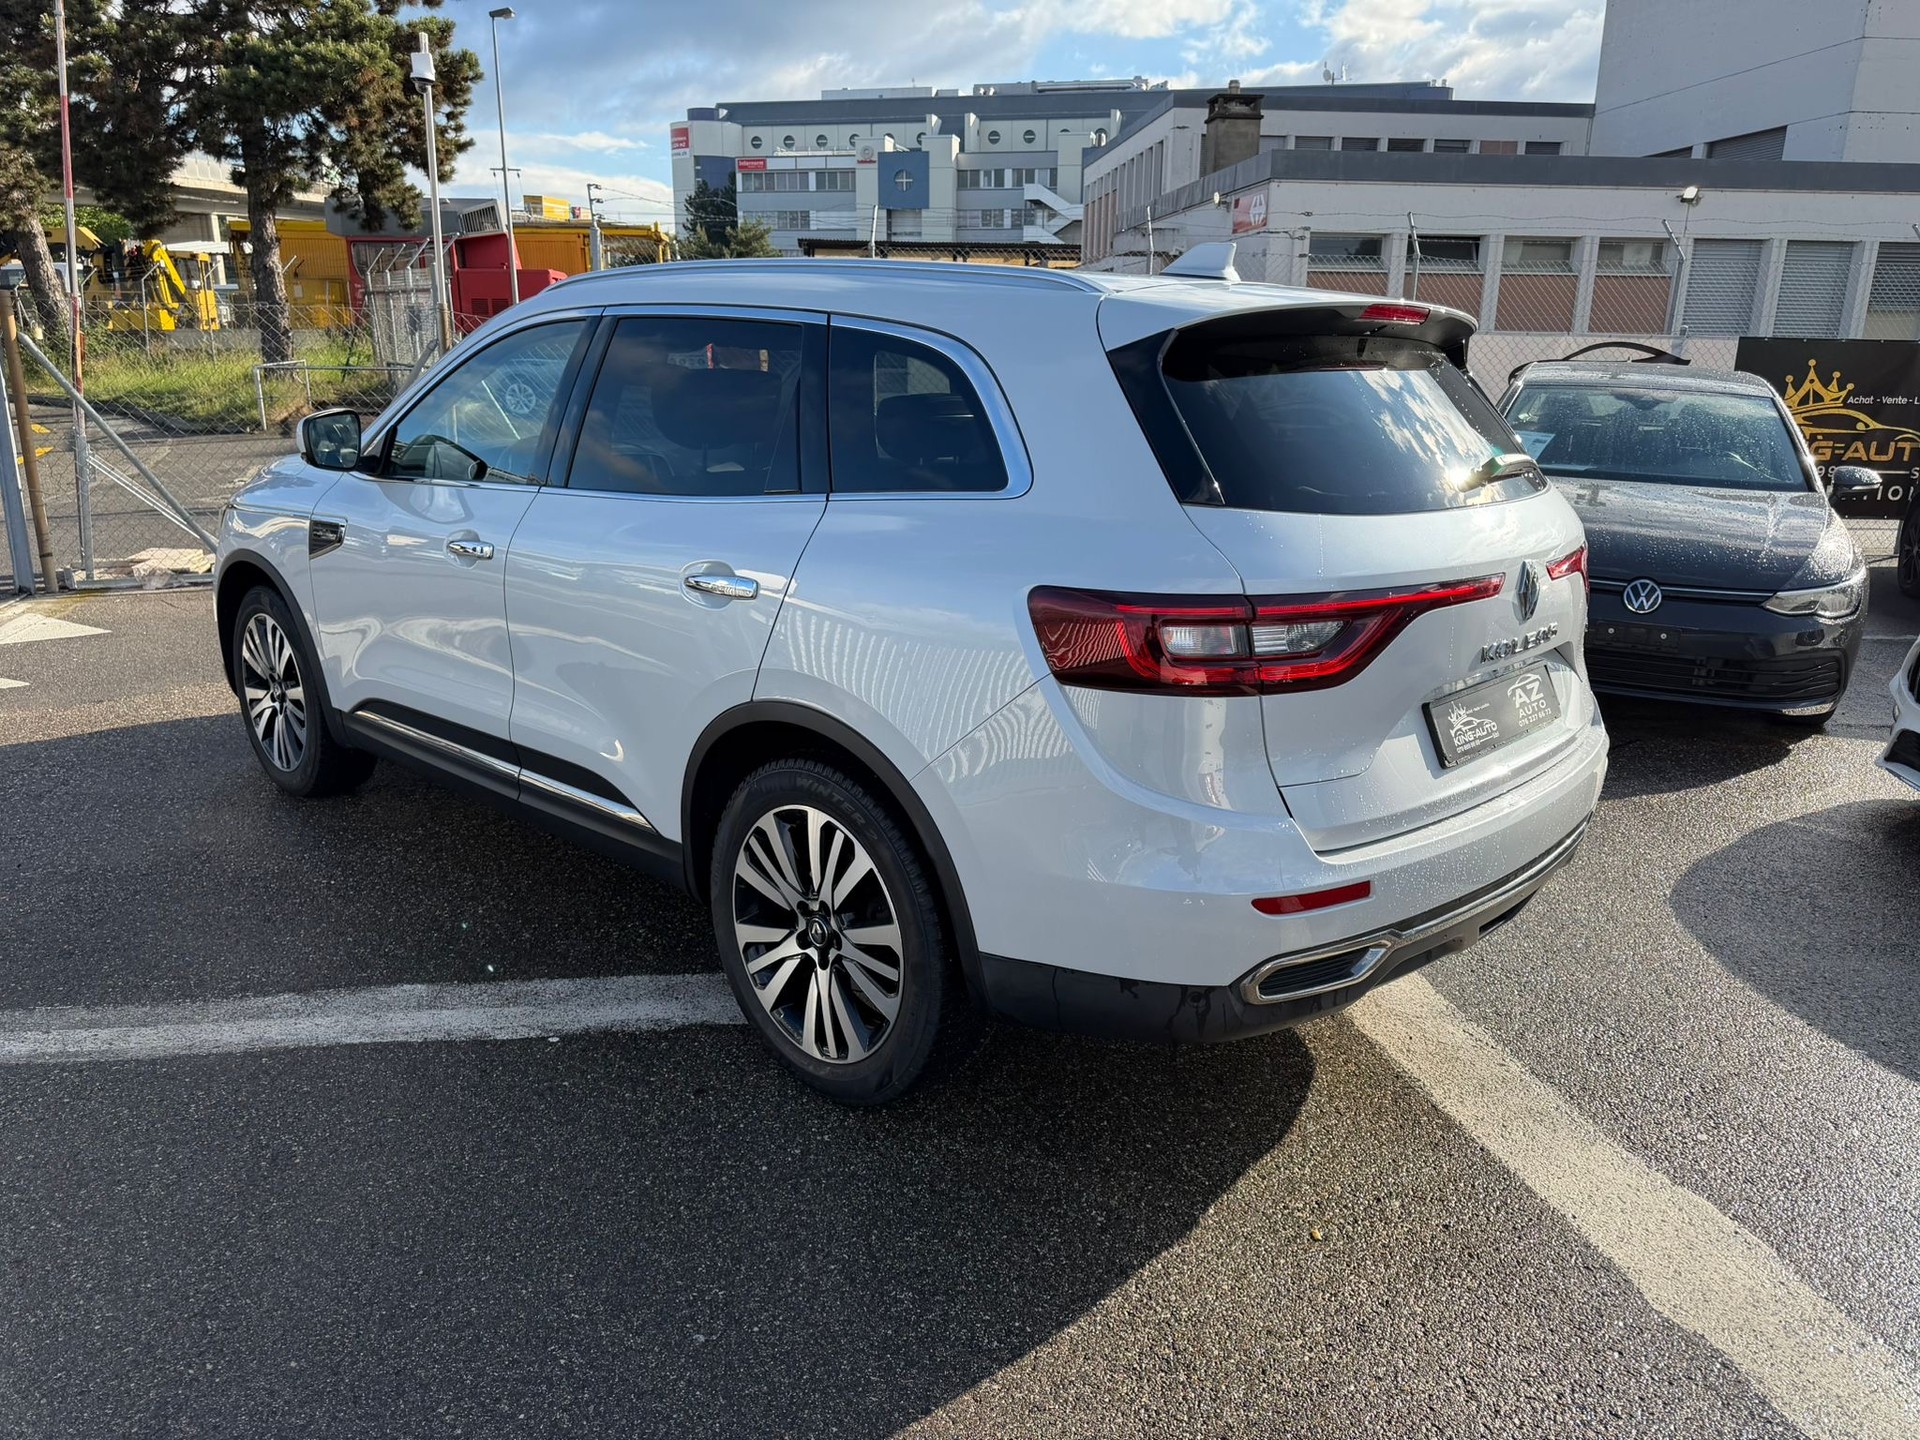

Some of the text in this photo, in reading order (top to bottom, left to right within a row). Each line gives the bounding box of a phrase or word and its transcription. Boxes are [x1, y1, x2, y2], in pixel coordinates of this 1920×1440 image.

[1847, 395, 1874, 405] Achat
[1882, 395, 1908, 405] Vente
[1515, 680, 1544, 708] AZ
[1519, 699, 1546, 718] AUTO
